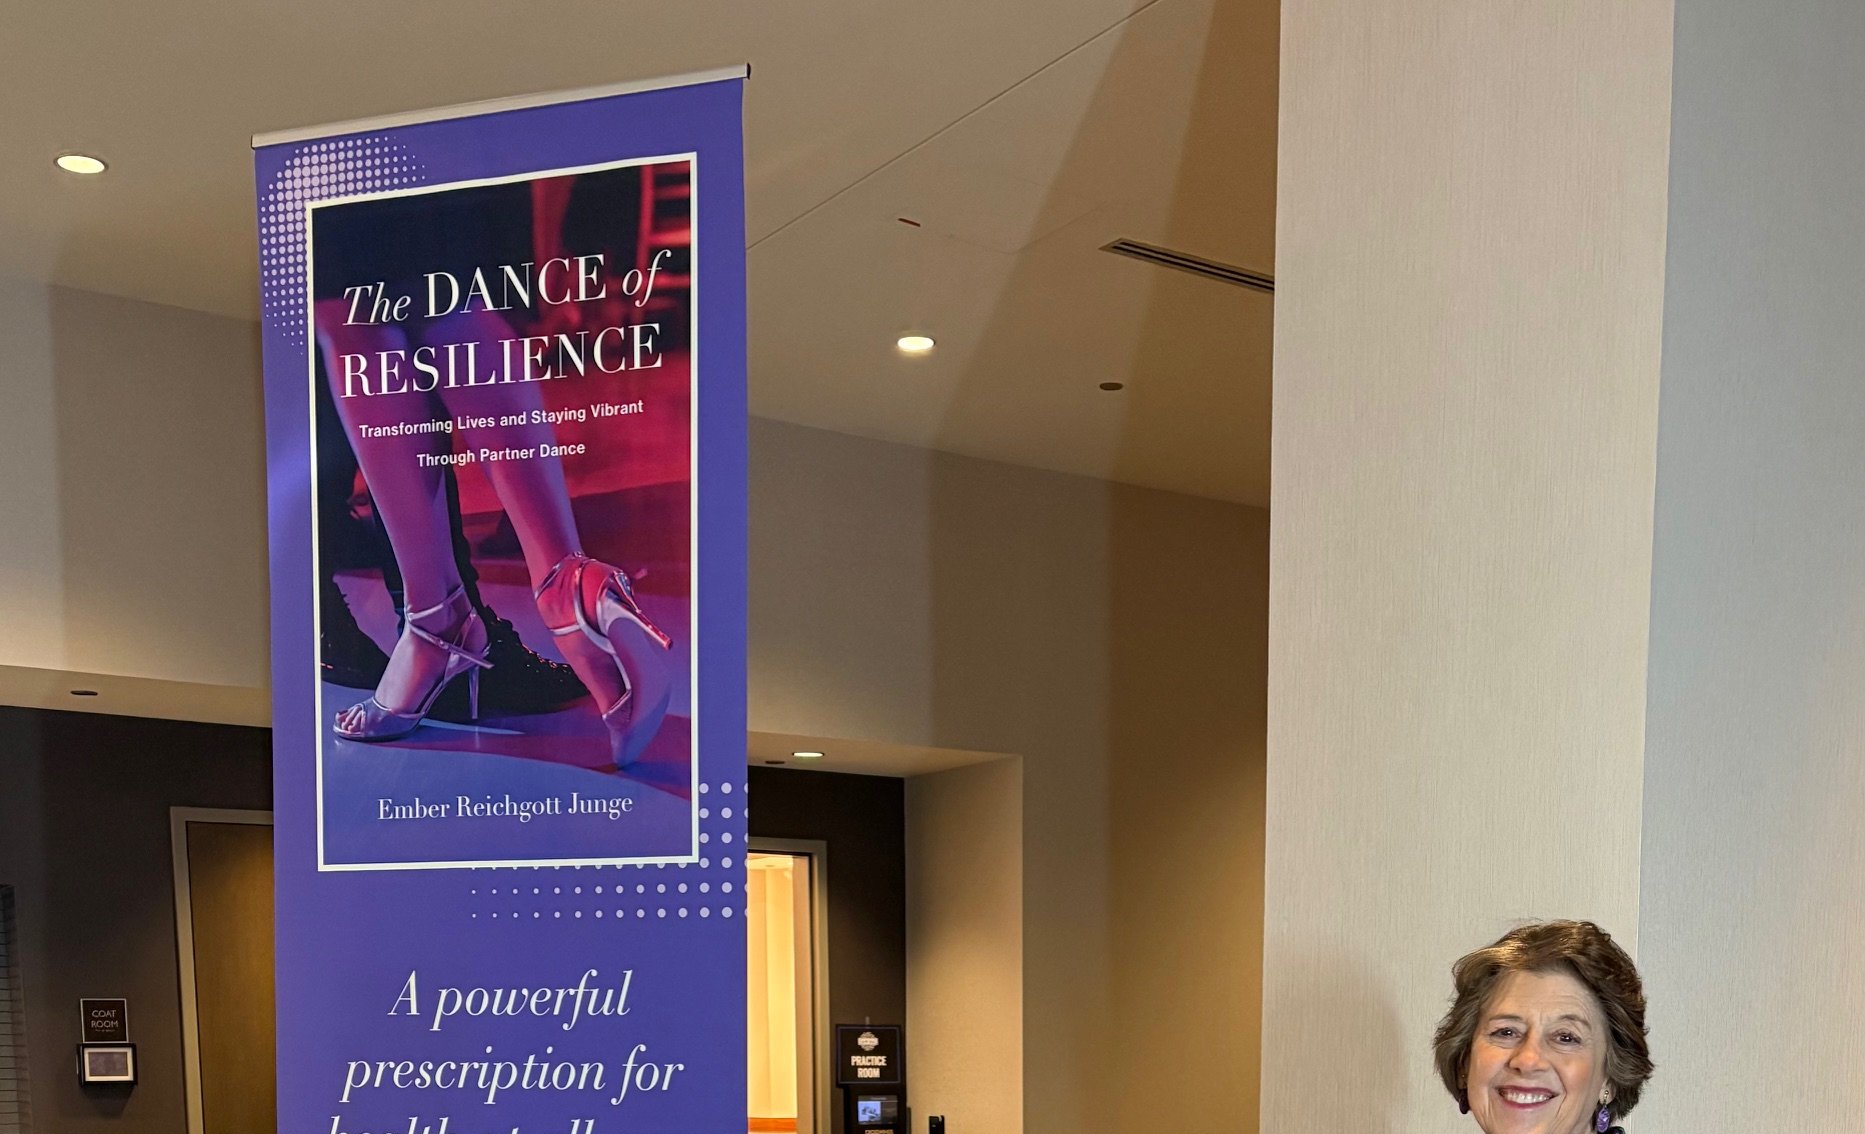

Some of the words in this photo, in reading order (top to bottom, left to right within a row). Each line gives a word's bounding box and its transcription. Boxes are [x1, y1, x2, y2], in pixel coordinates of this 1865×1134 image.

[342, 281, 412, 327] The
[422, 253, 608, 319] DANCE
[621, 248, 672, 308] of
[339, 322, 663, 398] RESILIENCE
[358, 415, 454, 439] Transforming
[457, 414, 495, 430] Lives
[499, 411, 527, 428] and
[530, 406, 587, 426] Staying
[590, 398, 644, 418] Vibrant
[416, 449, 476, 468] Through
[479, 445, 536, 463] Partner
[539, 441, 586, 458] Dance
[376, 797, 451, 820] Ember
[455, 794, 562, 823] Reichgott
[567, 792, 634, 820] Junge
[91, 1009, 117, 1018] COAT
[387, 969, 421, 1016] A
[428, 968, 634, 1032] powerful
[90, 1020, 119, 1028] ROOM
[338, 1045, 606, 1105] prescription
[610, 1043, 685, 1106] for
[850, 1055, 888, 1067] PRACTICE
[857, 1067, 881, 1078] ROOM
